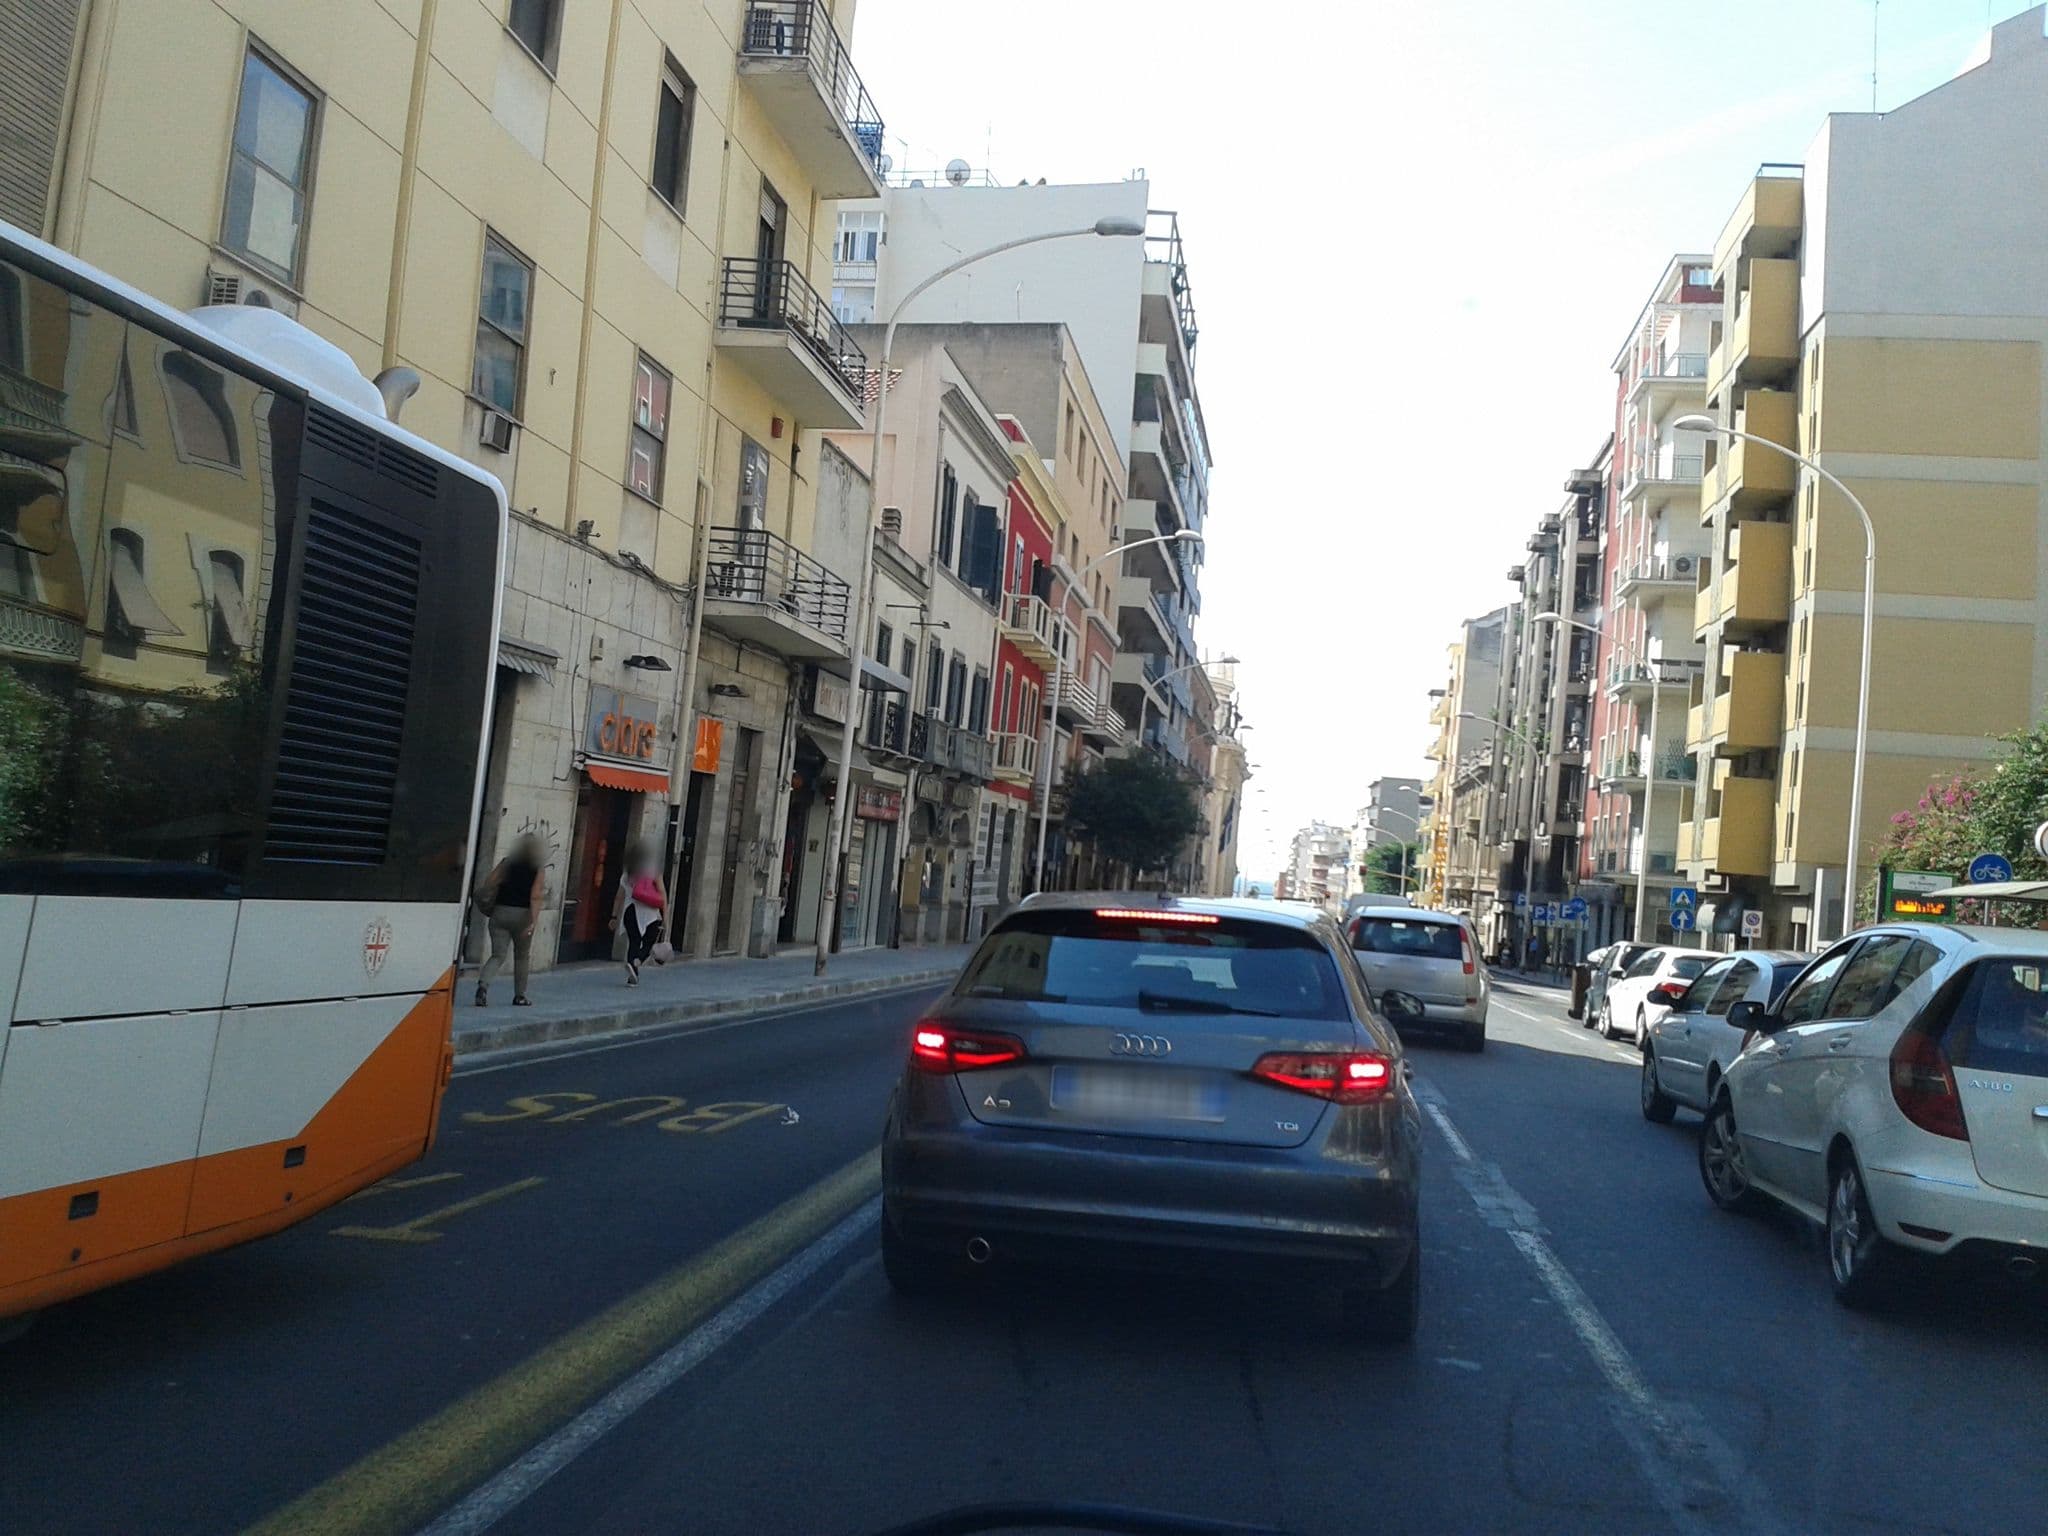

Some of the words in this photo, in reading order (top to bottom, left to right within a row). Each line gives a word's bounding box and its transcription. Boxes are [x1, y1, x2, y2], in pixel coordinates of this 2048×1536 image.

[1534, 905, 1546, 918] P
[462, 1092, 788, 1133] BUS
[1274, 1120, 1299, 1132] TDI
